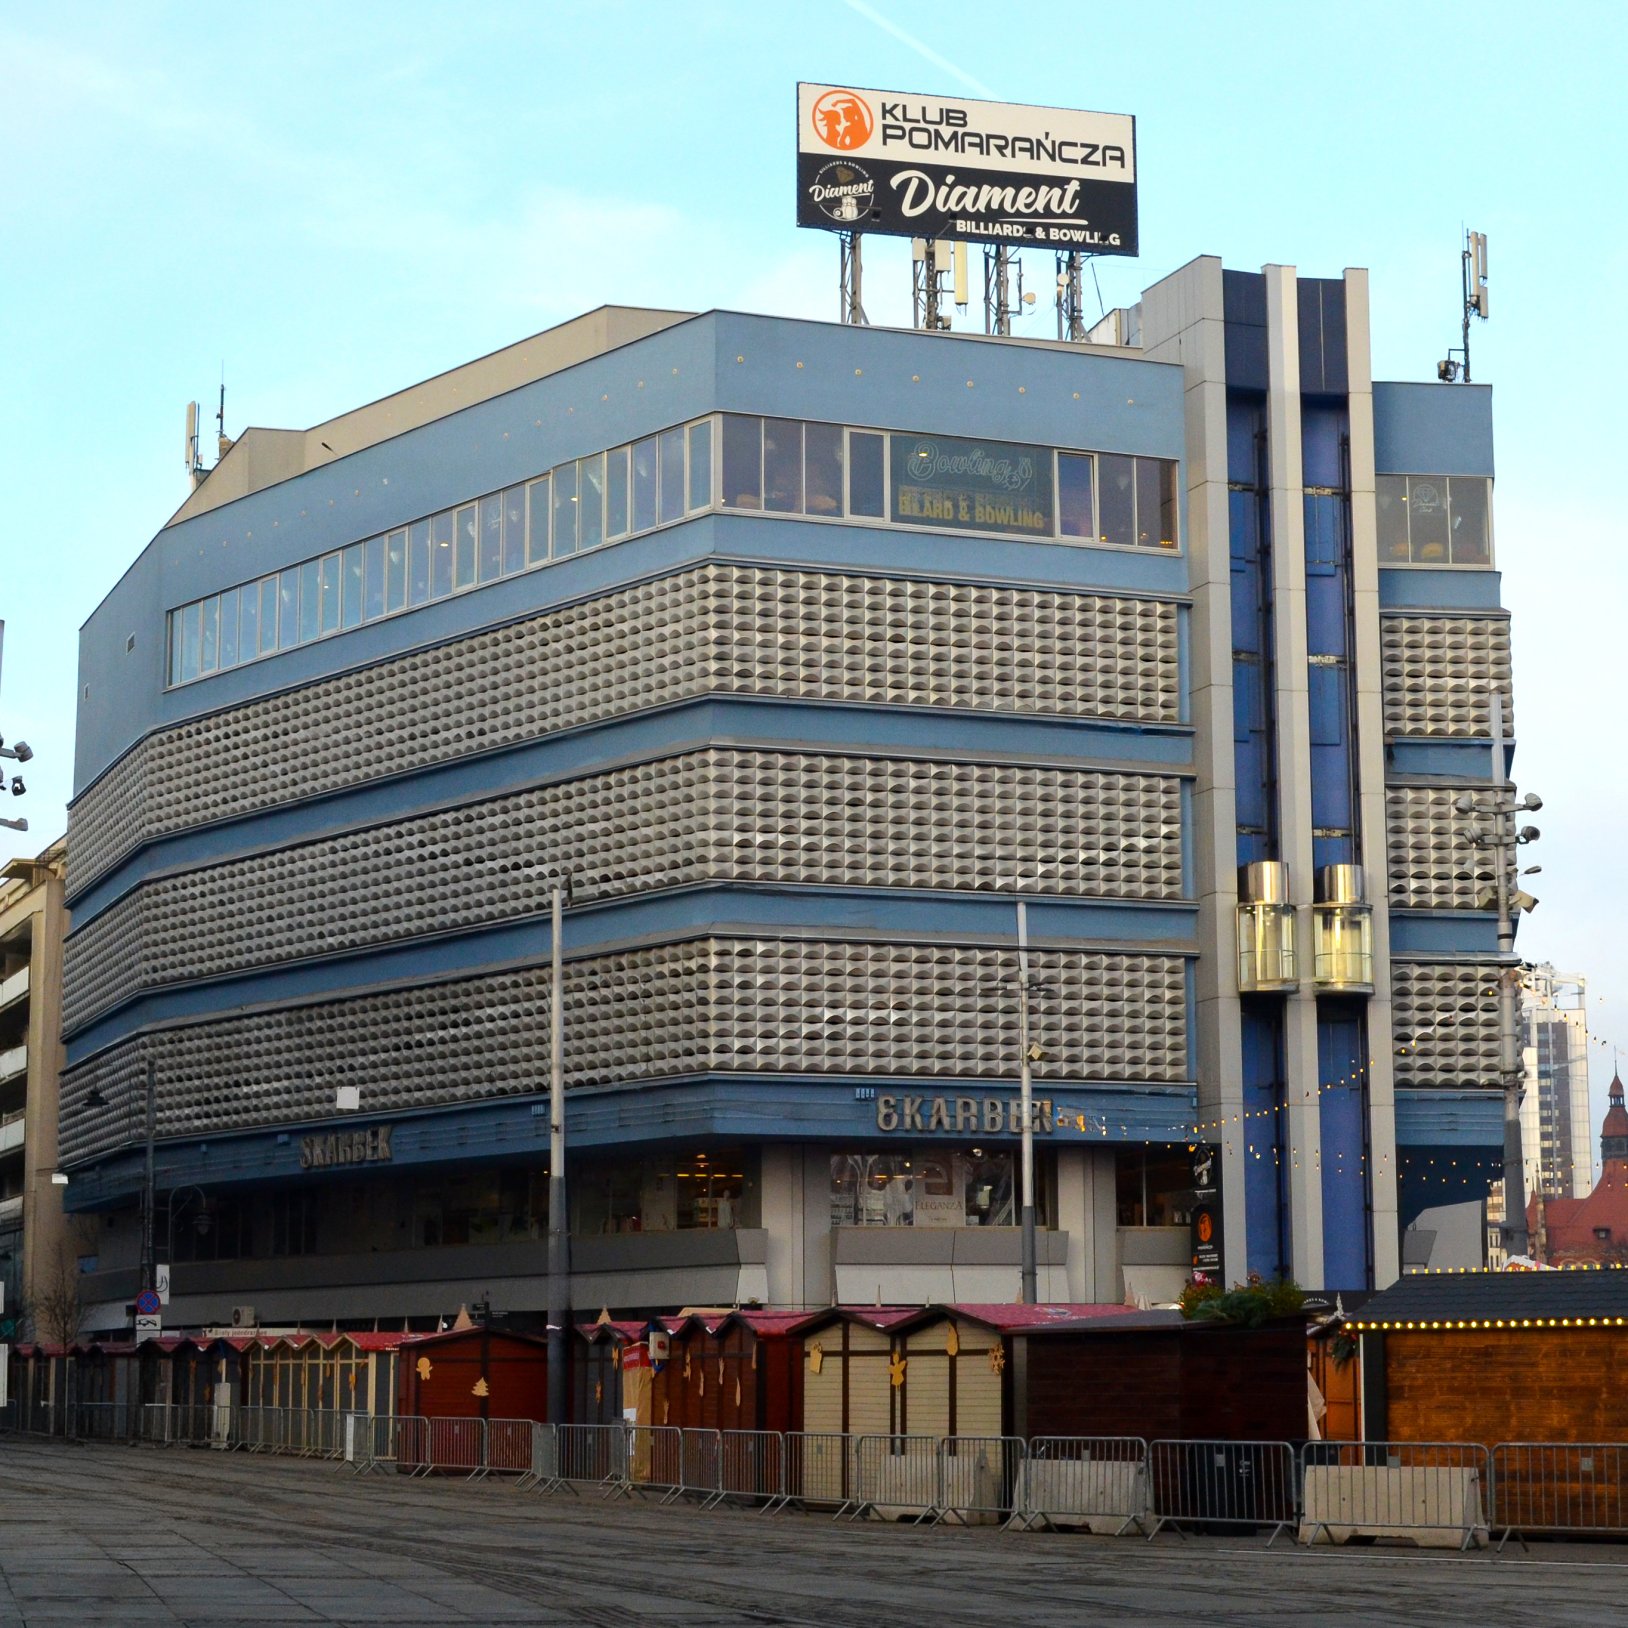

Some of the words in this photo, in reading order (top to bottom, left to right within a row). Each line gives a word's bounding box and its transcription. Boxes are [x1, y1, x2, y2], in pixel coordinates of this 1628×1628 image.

[881, 102, 968, 128] KLUB
[881, 124, 1126, 169] POMARAŃCZA
[809, 179, 874, 202] Diament
[890, 170, 1081, 217] Diament
[956, 219, 1033, 238] BILLIARD
[1035, 226, 1046, 239] &
[1049, 228, 1121, 246] BOWLIG
[907, 441, 1012, 483] Bowling
[975, 502, 1045, 529] BOWLING
